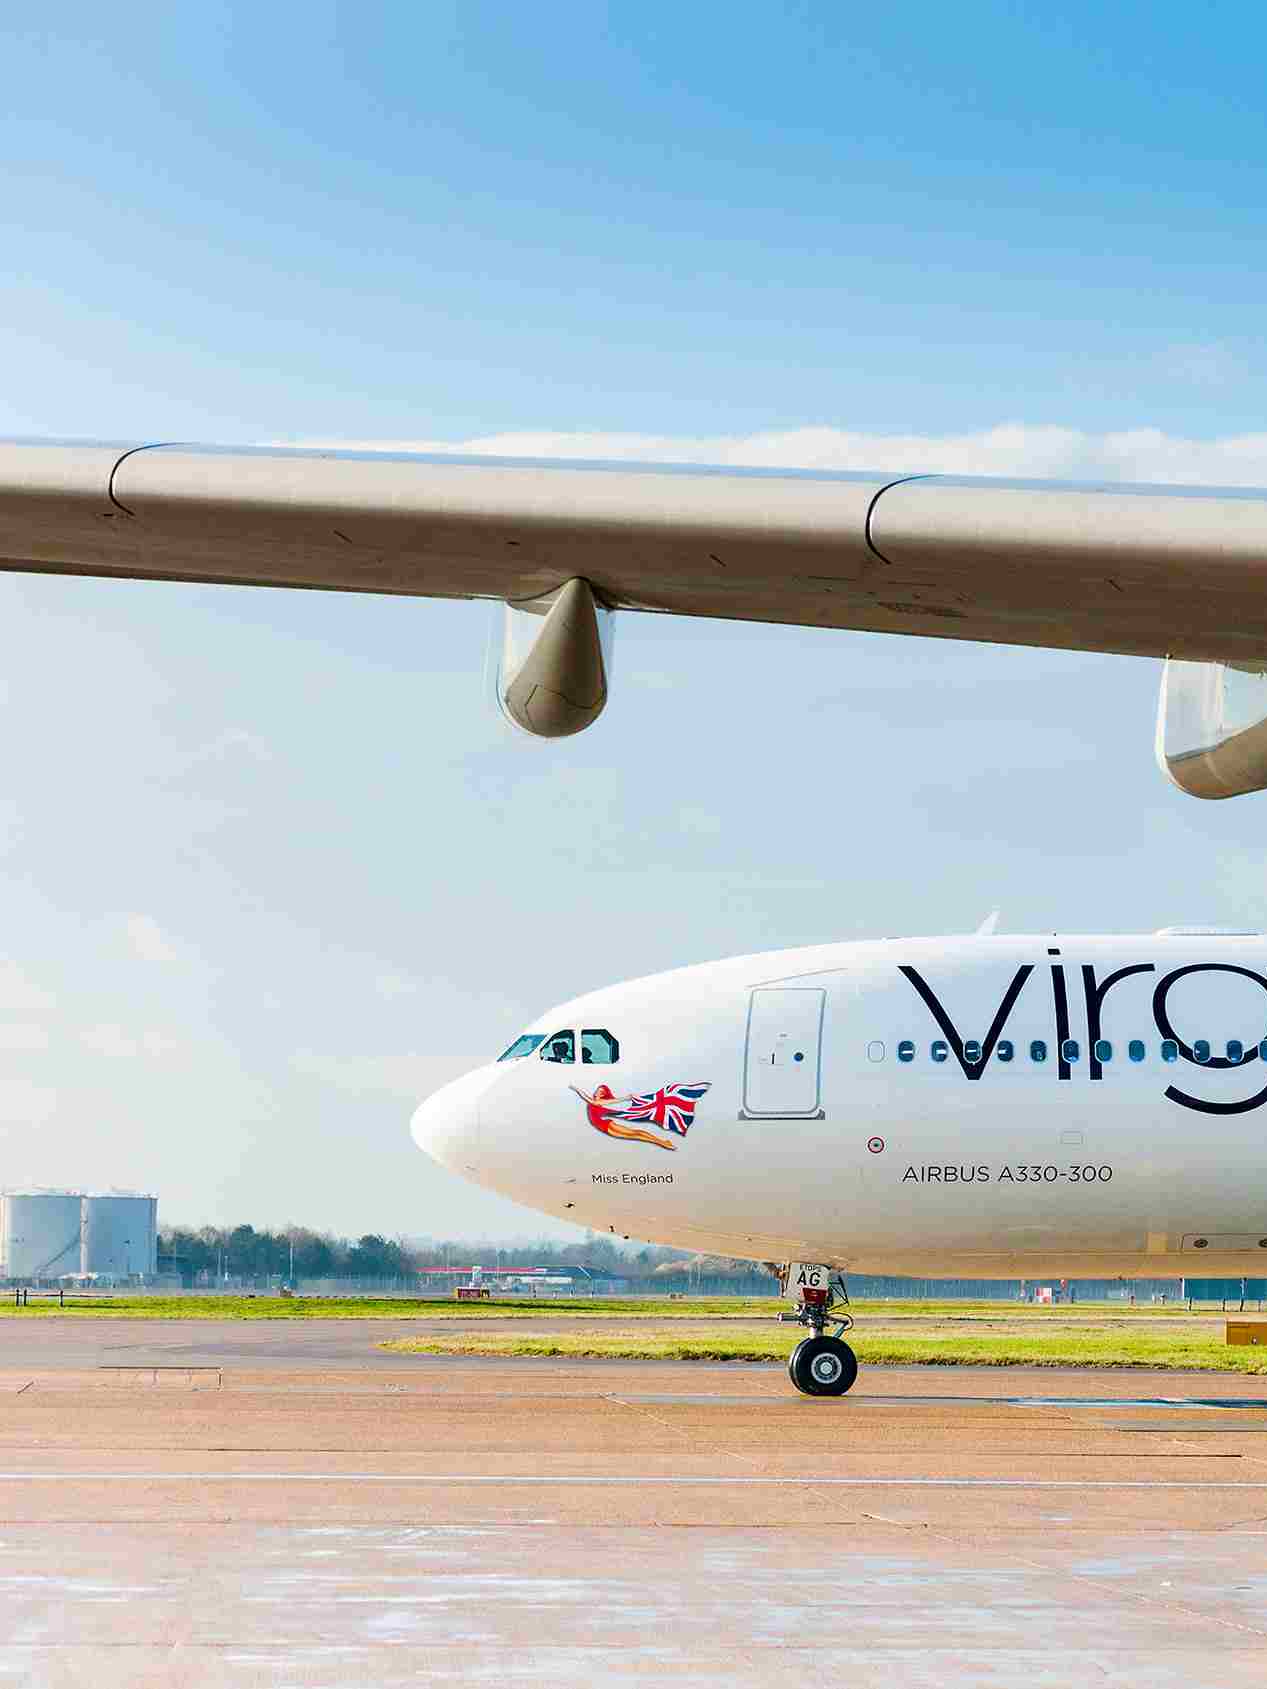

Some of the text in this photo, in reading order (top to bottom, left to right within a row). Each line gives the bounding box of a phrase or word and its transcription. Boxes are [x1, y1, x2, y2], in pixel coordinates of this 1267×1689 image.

[591, 1173, 674, 1186] Miss England
[902, 1166, 1113, 1183] AIRBUS A330-300
[796, 1270, 821, 1287] AG
